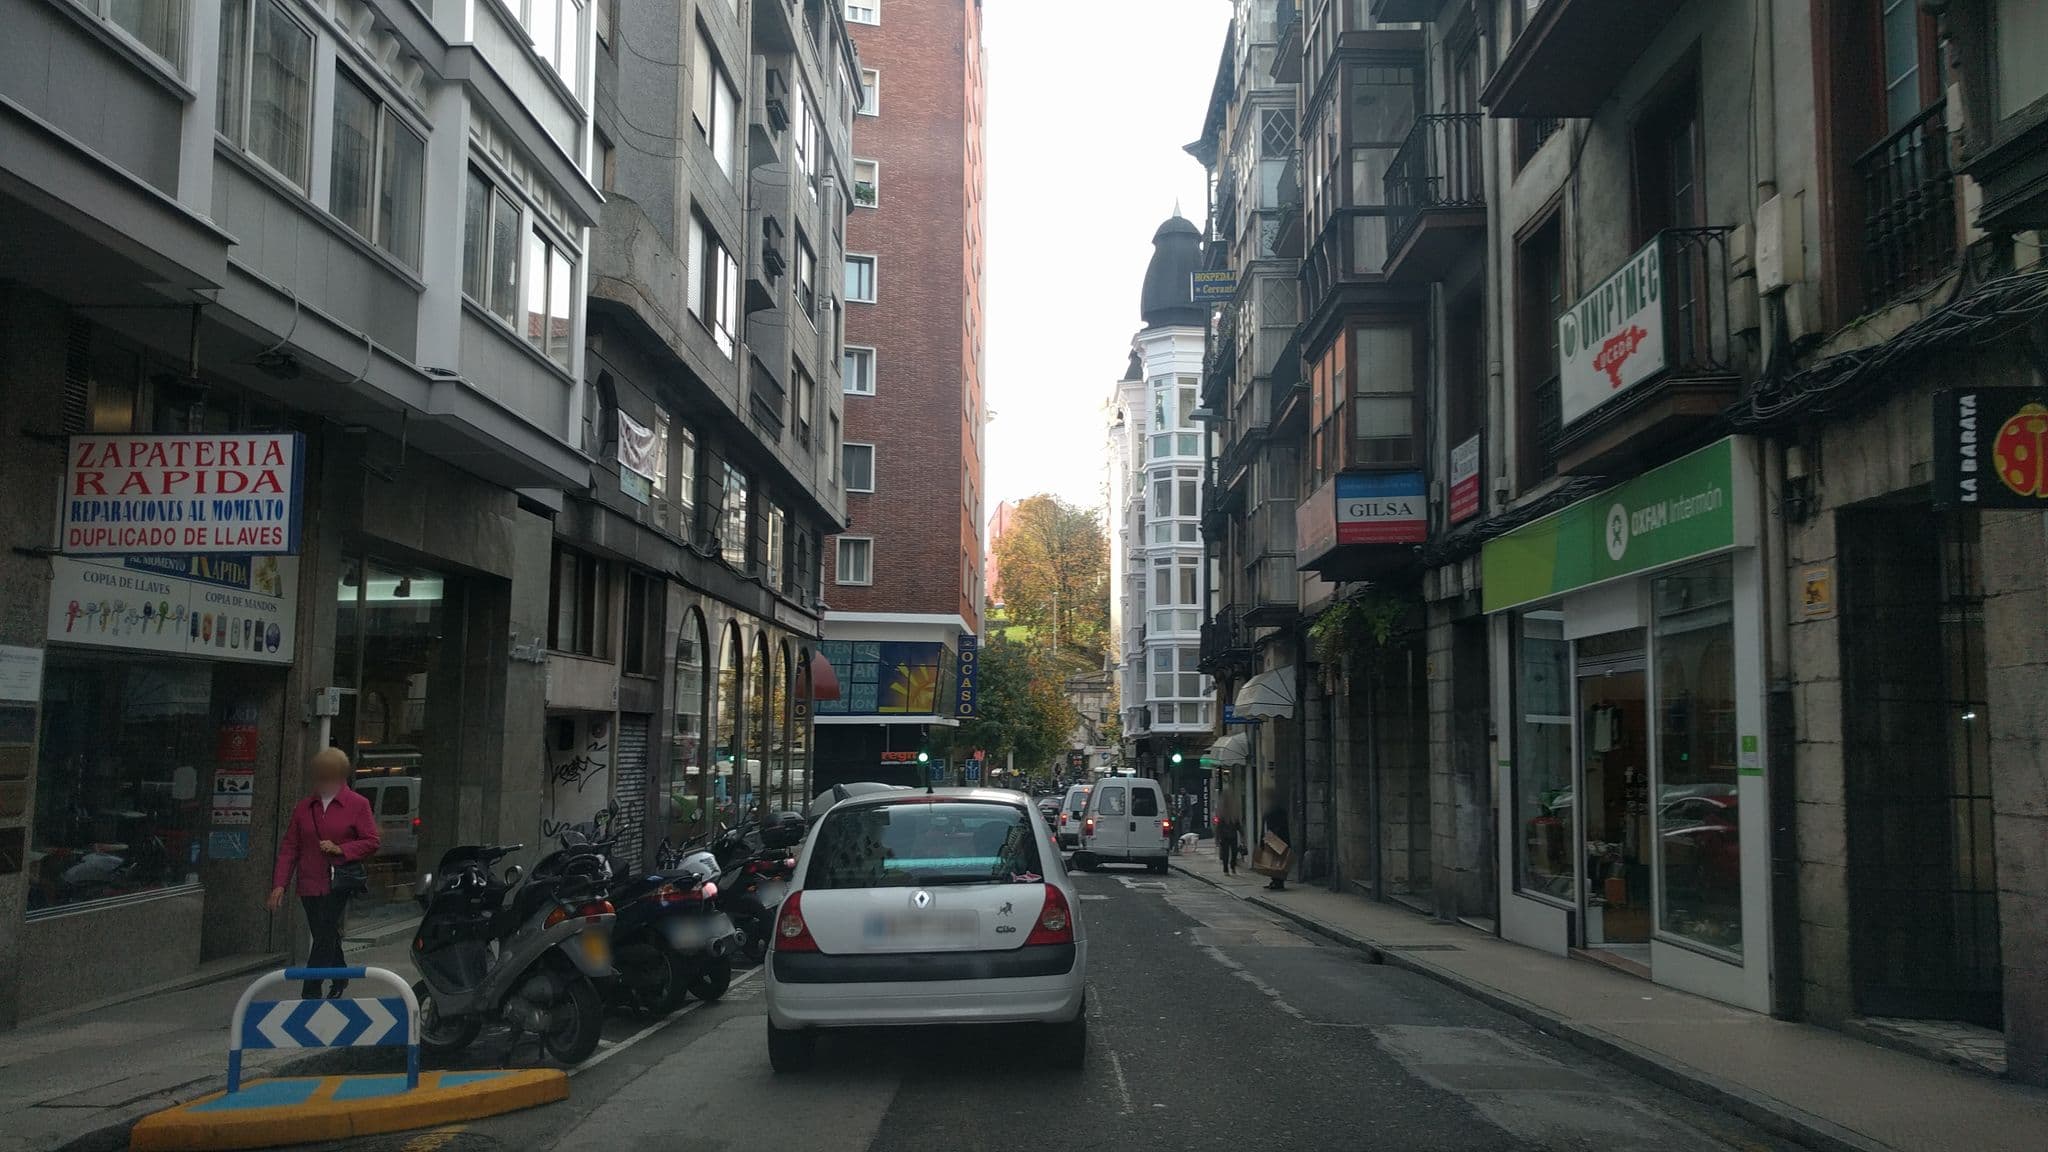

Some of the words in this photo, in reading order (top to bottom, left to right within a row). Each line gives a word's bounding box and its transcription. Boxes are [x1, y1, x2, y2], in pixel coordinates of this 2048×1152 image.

[1581, 248, 1658, 351] UNIPYMEC
[1959, 394, 1977, 472] BARATA
[76, 440, 285, 468] ZAPATERIA
[73, 469, 284, 496] RAPIDA
[1959, 478, 1977, 502] LA
[71, 499, 183, 522] REPARACIONES
[188, 499, 206, 522] AL
[212, 499, 284, 521] MOMENTO
[1350, 502, 1414, 517] GILSA
[1631, 500, 1668, 537] OXFAM
[1668, 480, 1722, 523] Intermón
[69, 527, 176, 547] DUPLICADO
[183, 526, 208, 546] DE
[214, 526, 283, 546] LLAVES
[83, 570, 117, 586] COPIA
[119, 576, 134, 590] DE
[135, 578, 171, 595] LLAVES
[205, 591, 231, 606] COPIA
[232, 596, 244, 607] DE
[244, 598, 278, 613] MANDOS
[959, 651, 974, 714] OCASO
